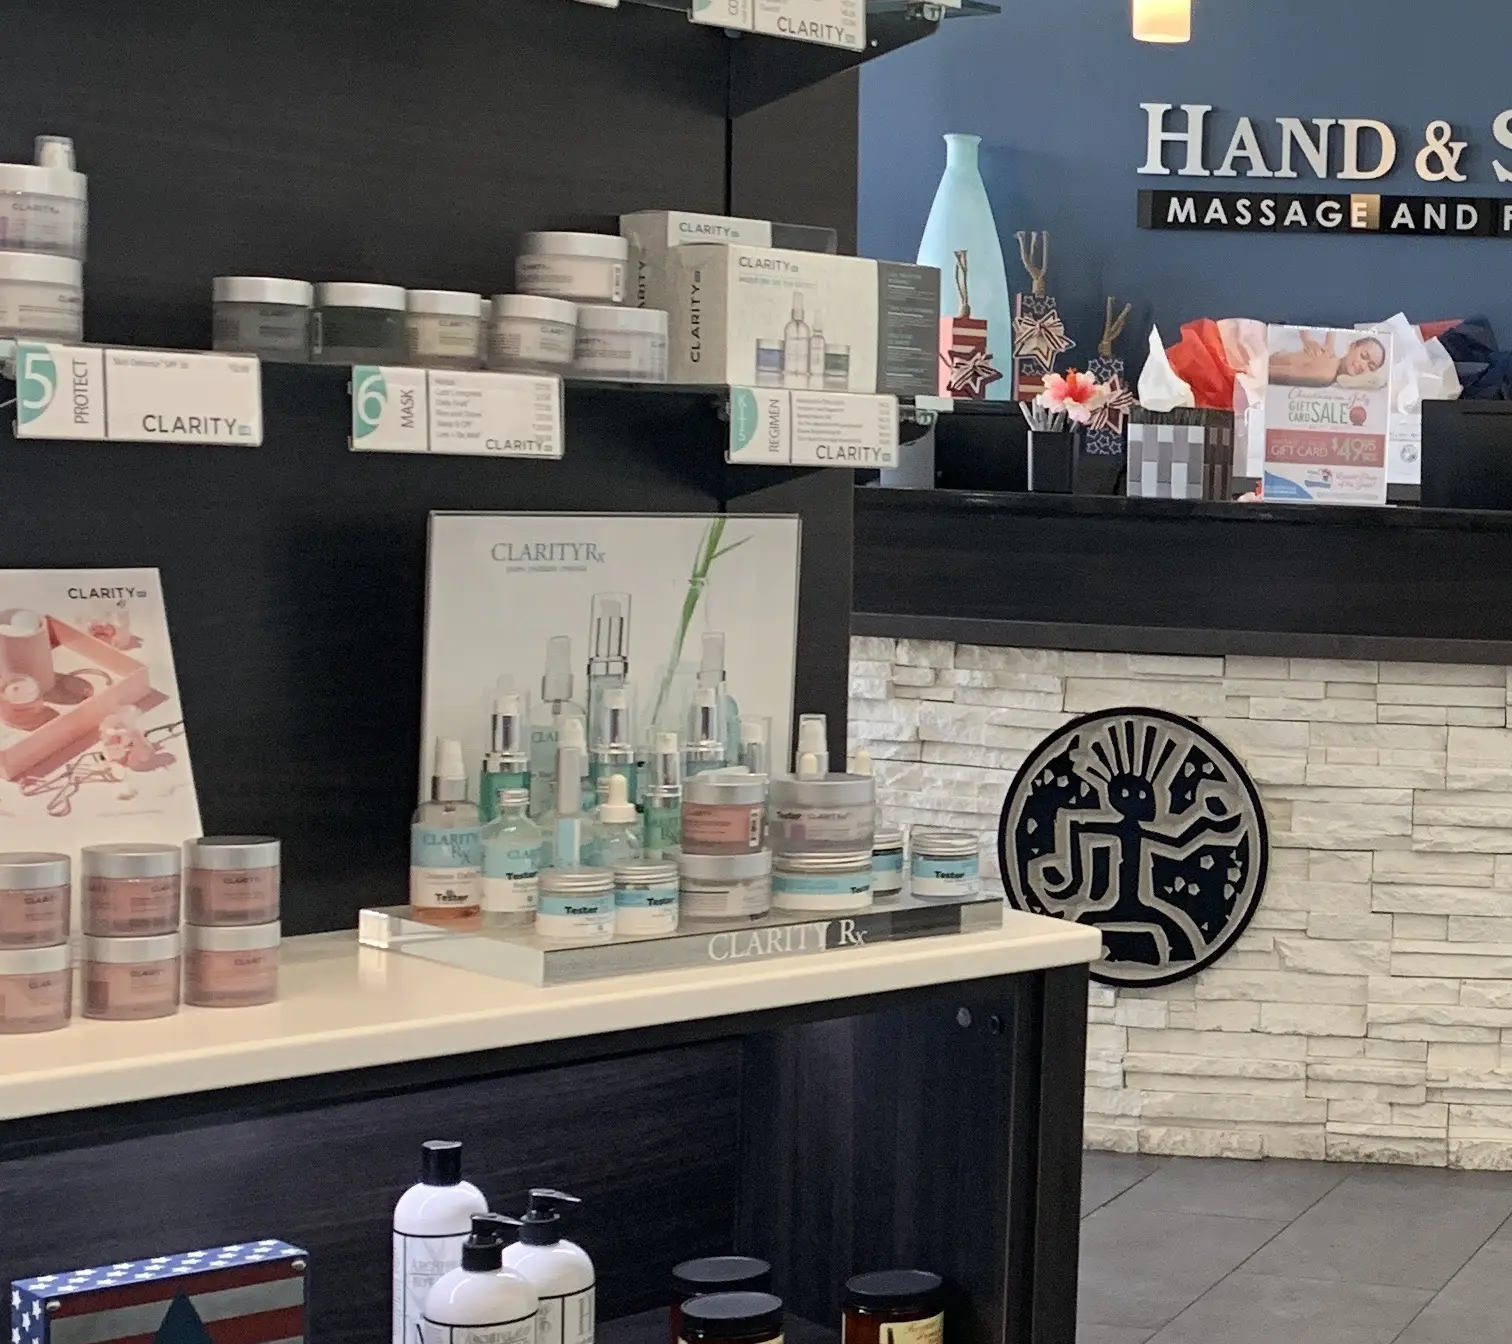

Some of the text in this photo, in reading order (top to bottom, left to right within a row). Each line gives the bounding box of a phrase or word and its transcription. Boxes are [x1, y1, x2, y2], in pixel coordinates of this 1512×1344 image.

[777, 16, 845, 42] CLARITY
[1136, 102, 1398, 180] HAND
[1414, 119, 1469, 183] &
[1166, 196, 1368, 228] MASSAGE
[1390, 202, 1479, 230] AND
[678, 221, 732, 238] CLARITY
[739, 256, 791, 272] CLARITY
[690, 284, 701, 363] CLARITY
[23, 353, 54, 410] 5
[72, 358, 89, 424] PROTECT
[357, 373, 387, 425] 6
[400, 389, 415, 429] MASK
[1288, 400, 1349, 425] GIFT SALE
[1288, 411, 1311, 423] CARD
[142, 414, 237, 436] CLARITY
[768, 399, 781, 453] REGIMEN
[485, 438, 543, 452] CLARITY
[815, 444, 882, 462] CLARITY
[1271, 445, 1295, 456] GIFT
[1296, 446, 1328, 457] CARD
[67, 587, 135, 599] CLARITY
[933, 870, 965, 879] Tester
[434, 892, 469, 902] Tester
[646, 896, 676, 906] Tester
[564, 906, 599, 915] Tester
[708, 921, 832, 961] CLARITY
